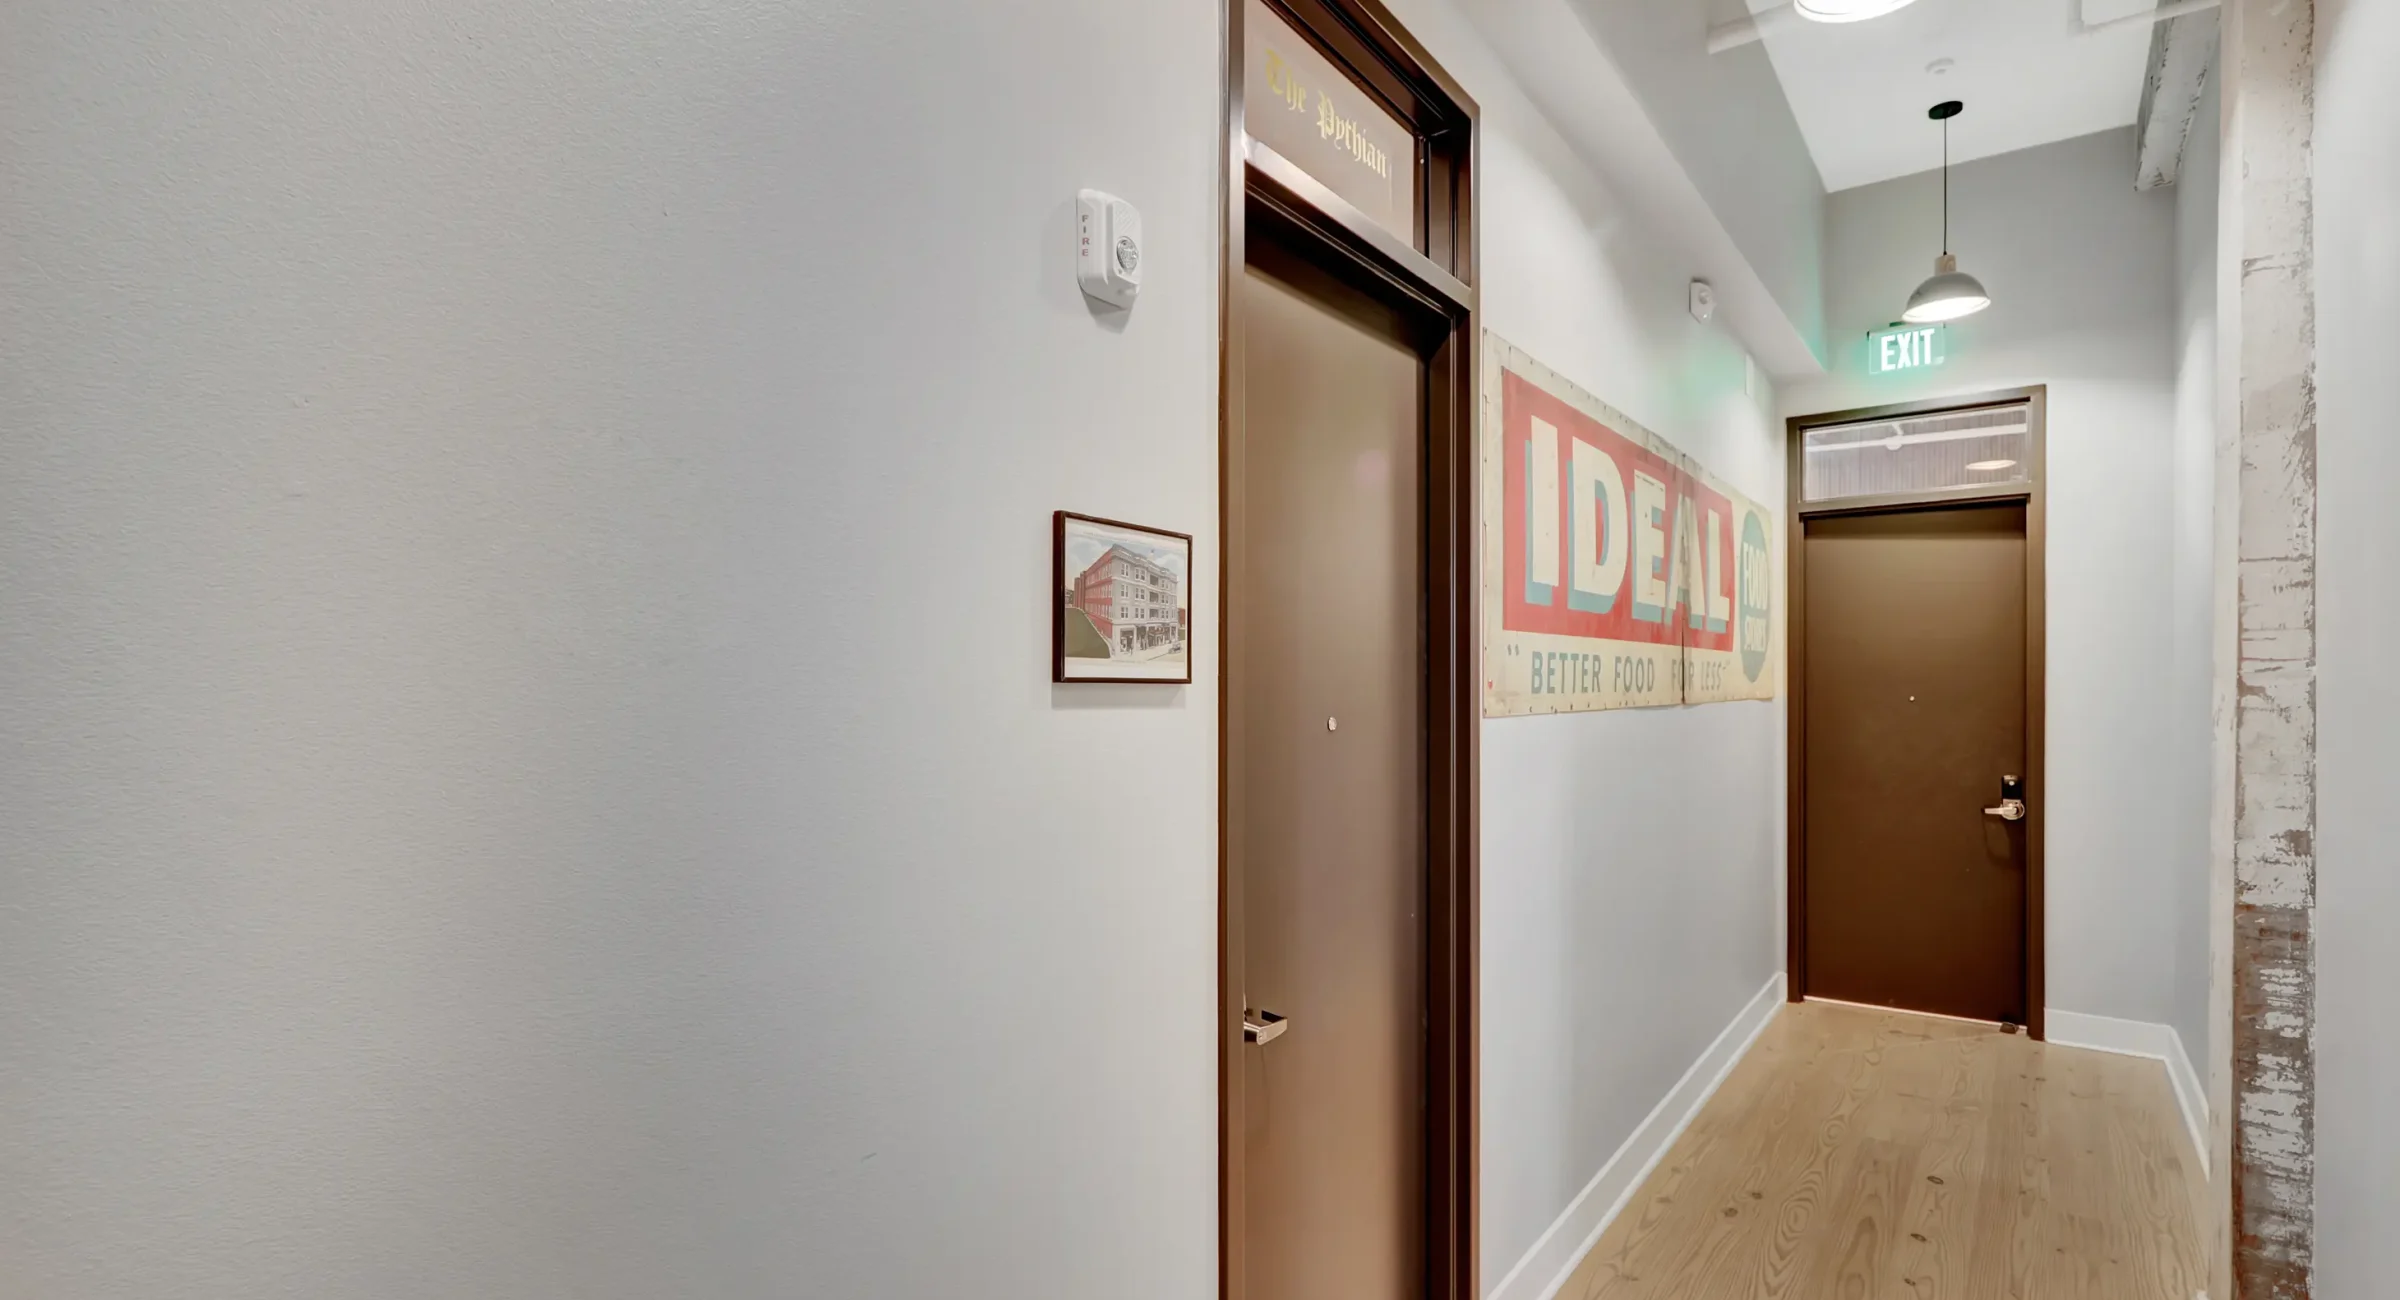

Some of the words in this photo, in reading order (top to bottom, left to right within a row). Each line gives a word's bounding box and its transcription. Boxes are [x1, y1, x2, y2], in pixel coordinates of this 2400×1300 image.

[1265, 48, 1307, 112] The
[1316, 89, 1388, 179] Pythian
[1081, 214, 1091, 257] FIRE
[1881, 328, 1935, 371] EXIT
[1525, 415, 1730, 633] IDEAL
[1743, 541, 1768, 611] FOOD
[1614, 655, 1655, 693] FOOD
[1671, 658, 1695, 692] FOR
